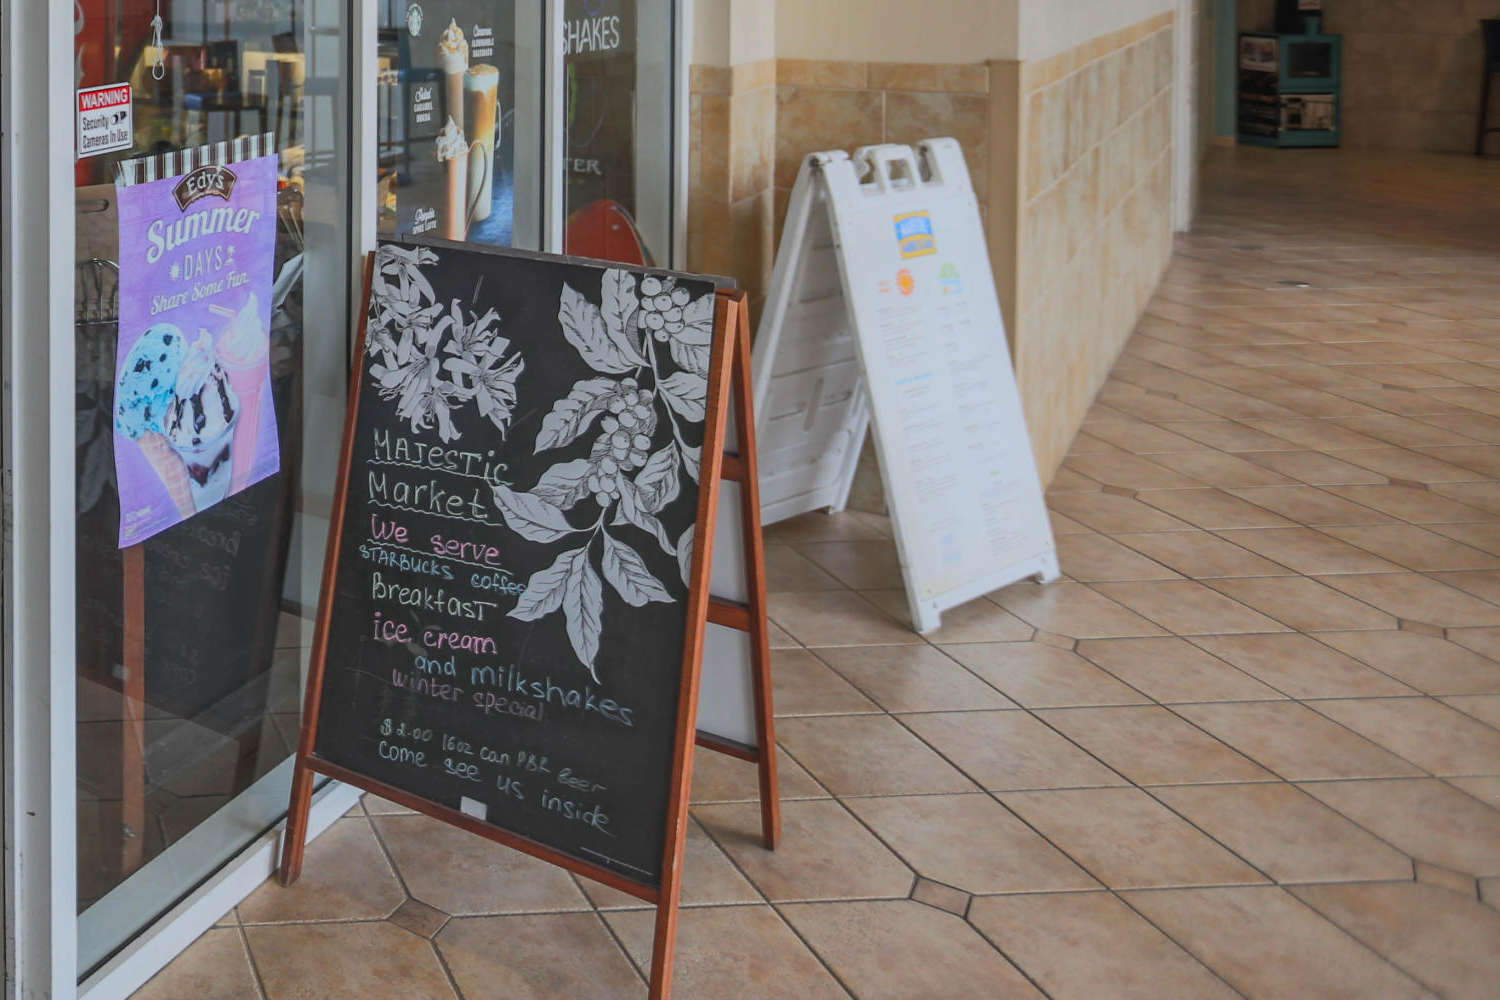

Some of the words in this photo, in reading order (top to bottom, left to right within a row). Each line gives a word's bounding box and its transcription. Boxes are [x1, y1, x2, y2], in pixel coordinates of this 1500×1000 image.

[80, 88, 129, 109] WARNING
[82, 134, 109, 149] Cameras
[109, 130, 116, 144] In
[116, 128, 129, 142] Use
[83, 114, 109, 131] Security
[185, 170, 225, 195] Edy's
[146, 207, 261, 264] Summer
[183, 245, 223, 281] DAYS
[150, 291, 190, 316] Share
[191, 279, 224, 302] Some
[368, 470, 488, 519] Market
[371, 514, 409, 544] We
[429, 534, 501, 566] serve
[470, 572, 528, 596] coffee
[423, 629, 498, 654] cream
[392, 668, 464, 702] winter
[472, 691, 544, 722] special
[414, 655, 457, 677] and
[470, 664, 634, 727] milkshakes
[480, 746, 511, 766] can
[443, 757, 483, 782] see
[540, 788, 617, 838] inside
